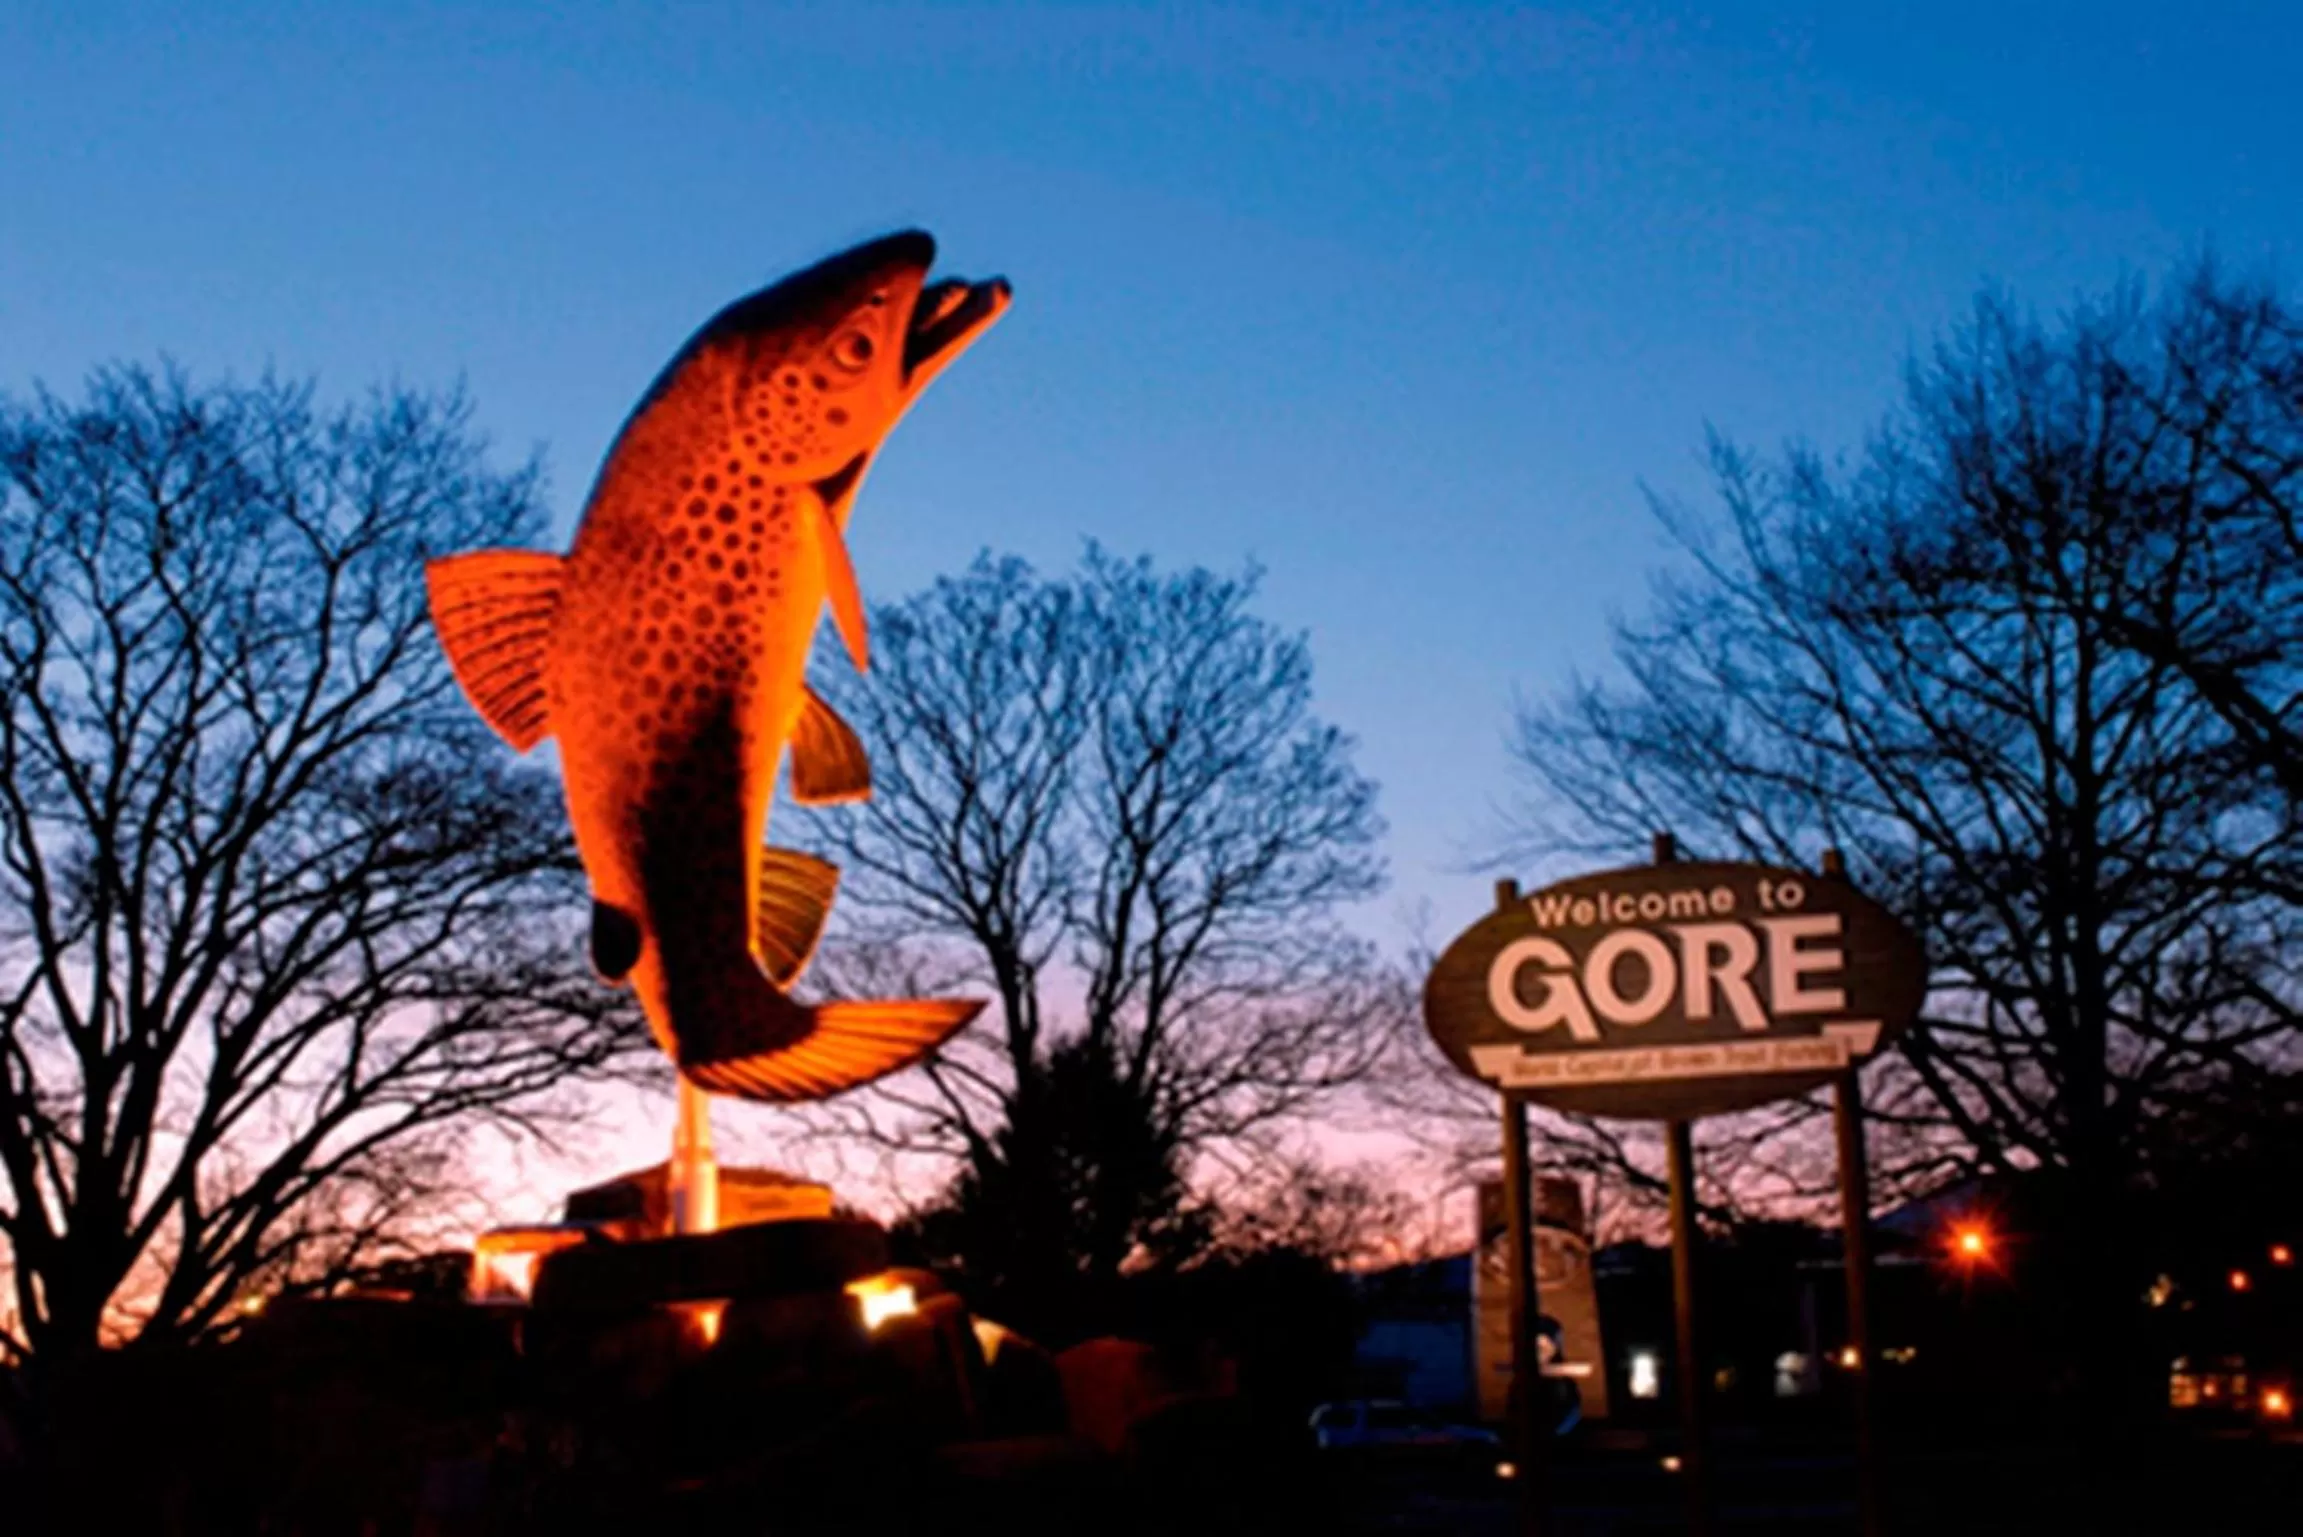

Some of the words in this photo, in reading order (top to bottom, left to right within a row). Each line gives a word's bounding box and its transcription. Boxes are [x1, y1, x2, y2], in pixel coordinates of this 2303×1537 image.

[1531, 885, 1736, 928] Welcome
[1757, 878, 1805, 910] to
[1488, 913, 1846, 1041] GORE
